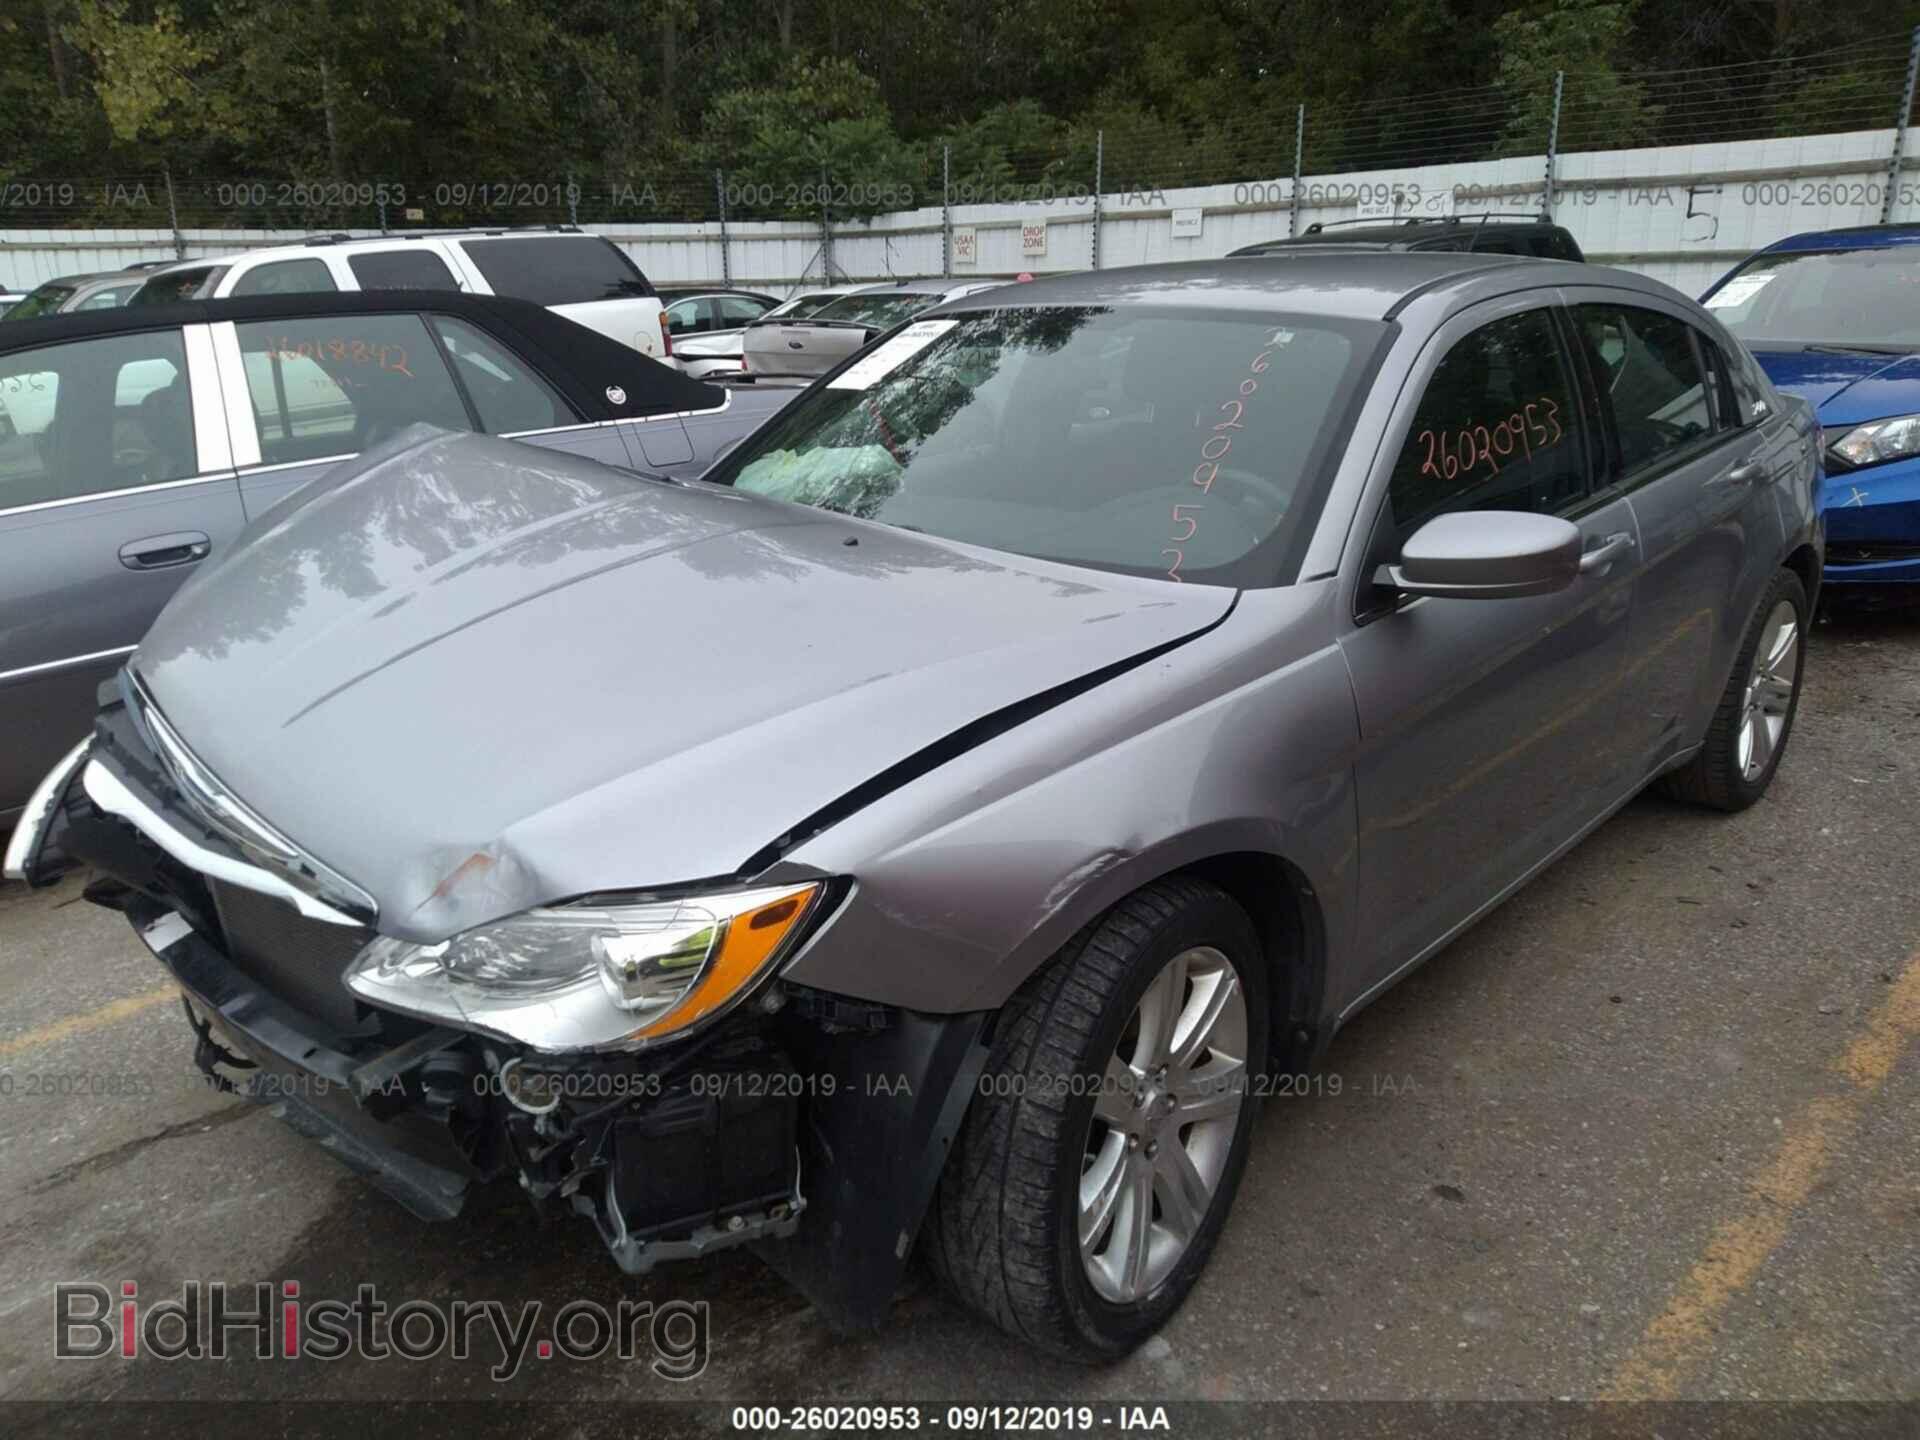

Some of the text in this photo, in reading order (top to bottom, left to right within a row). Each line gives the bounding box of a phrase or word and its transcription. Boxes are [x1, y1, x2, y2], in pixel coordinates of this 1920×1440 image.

[1023, 226, 1045, 237] DROP
[1023, 238, 1044, 248] ZONE
[1418, 397, 1563, 480] 26020953
